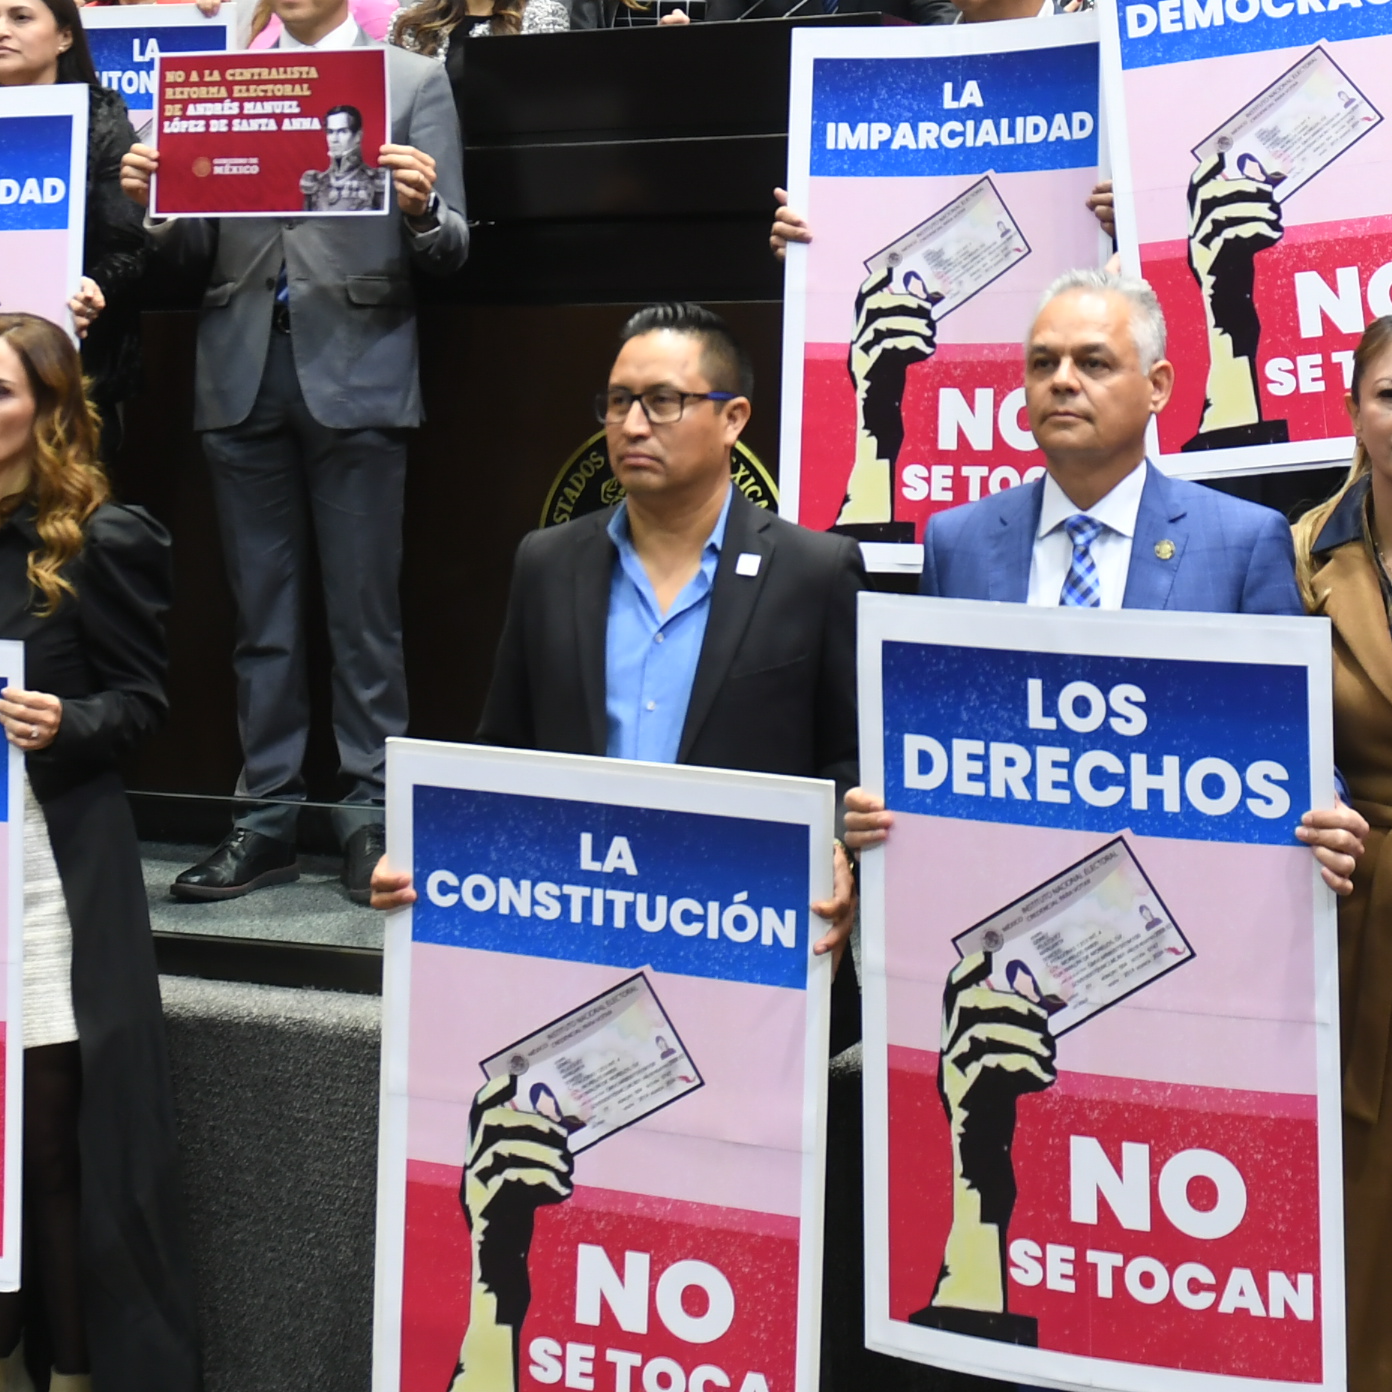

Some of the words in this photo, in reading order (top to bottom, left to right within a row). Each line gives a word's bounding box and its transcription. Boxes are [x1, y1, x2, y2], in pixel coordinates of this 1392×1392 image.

[166, 71, 185, 82] NO
[189, 70, 199, 81] A
[204, 70, 221, 81] LA
[226, 67, 319, 80] CENTRALISTA
[166, 86, 228, 99] REFORMA
[233, 84, 311, 97] ELECTORAL
[943, 81, 983, 109] LA
[164, 104, 182, 116] DE
[243, 101, 300, 114] MANUEL
[210, 120, 228, 131] DE
[232, 118, 278, 131] SANTA
[282, 117, 321, 130] ANNA
[826, 112, 1093, 149] IMPARCIALIDAD
[1028, 679, 1147, 736] LOS
[904, 734, 1290, 818] DERECHOS
[581, 833, 637, 875] LA
[427, 870, 796, 948] CONSTITUCIÓN
[1070, 1135, 1246, 1239] NO
[576, 1244, 734, 1343] NO
[1009, 1239, 1075, 1292] SE
[1087, 1250, 1313, 1320] TOCAN
